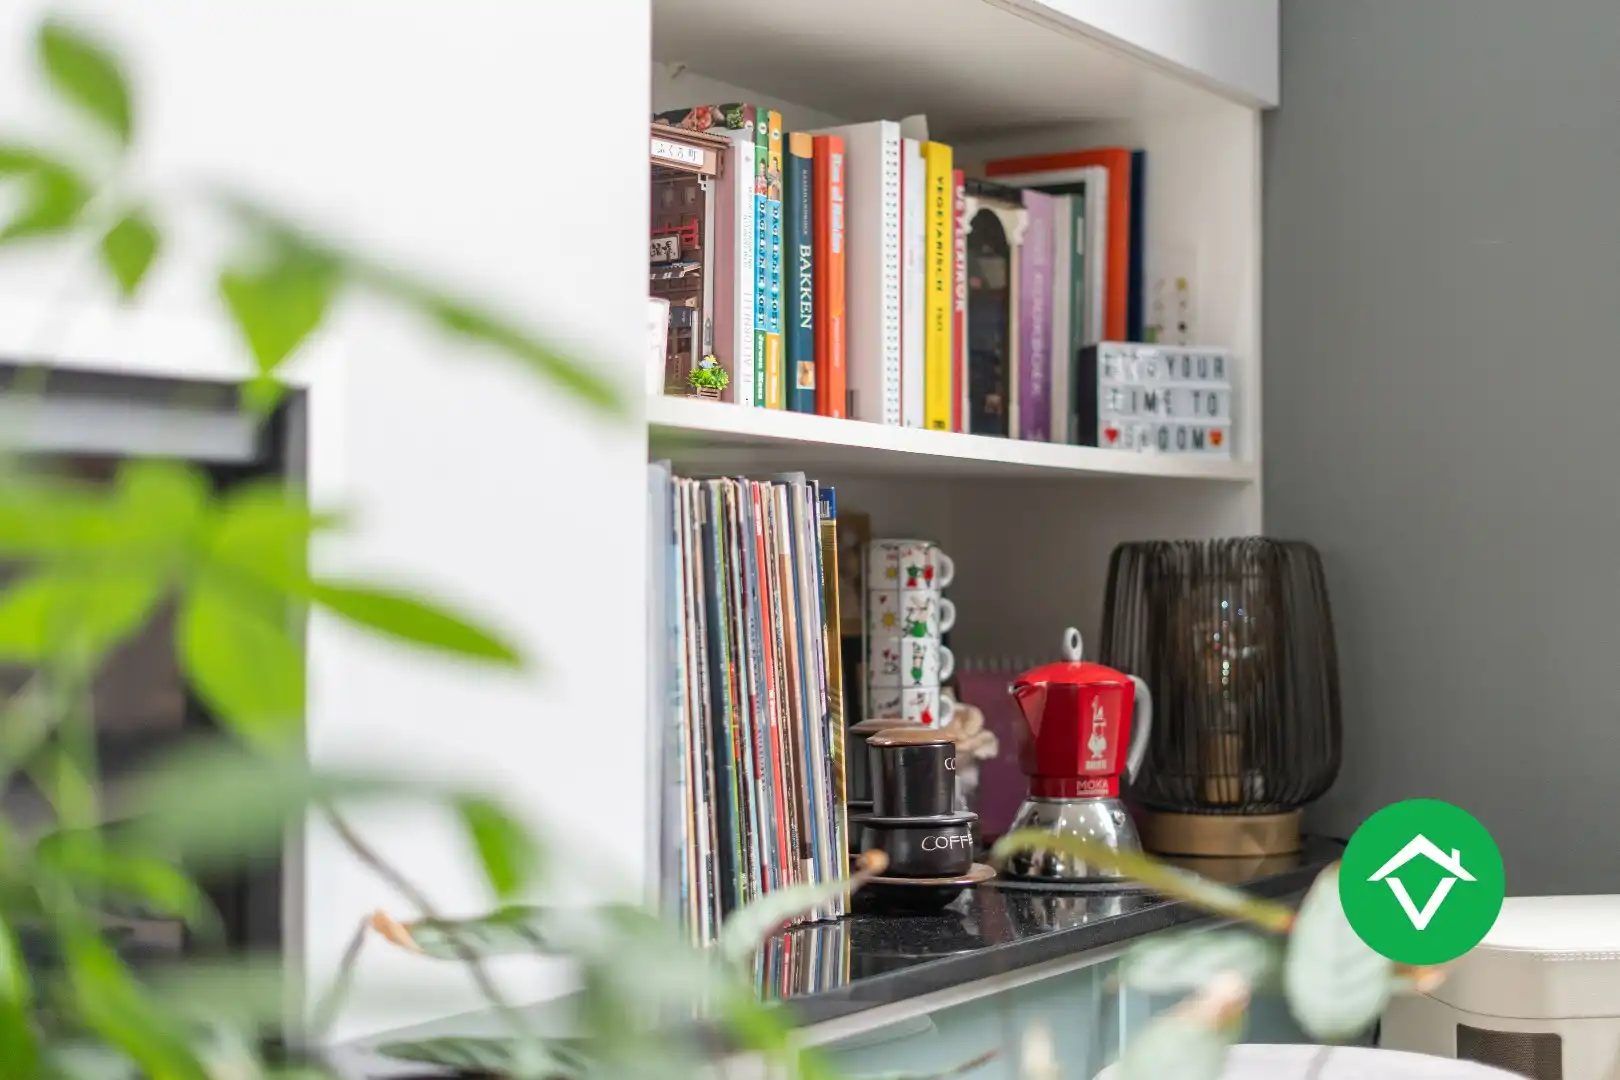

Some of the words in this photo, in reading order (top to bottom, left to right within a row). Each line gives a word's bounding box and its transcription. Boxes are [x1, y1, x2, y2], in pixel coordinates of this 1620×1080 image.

[758, 200, 766, 286] DAGELIJKSE
[935, 176, 944, 292] VEGETARISCH
[799, 244, 812, 330] BAKKEN
[757, 288, 766, 326] KOST
[771, 293, 779, 329] KOST
[1165, 354, 1224, 378] YOUR
[1192, 390, 1218, 416] TO
[1076, 779, 1108, 790] MOKA
